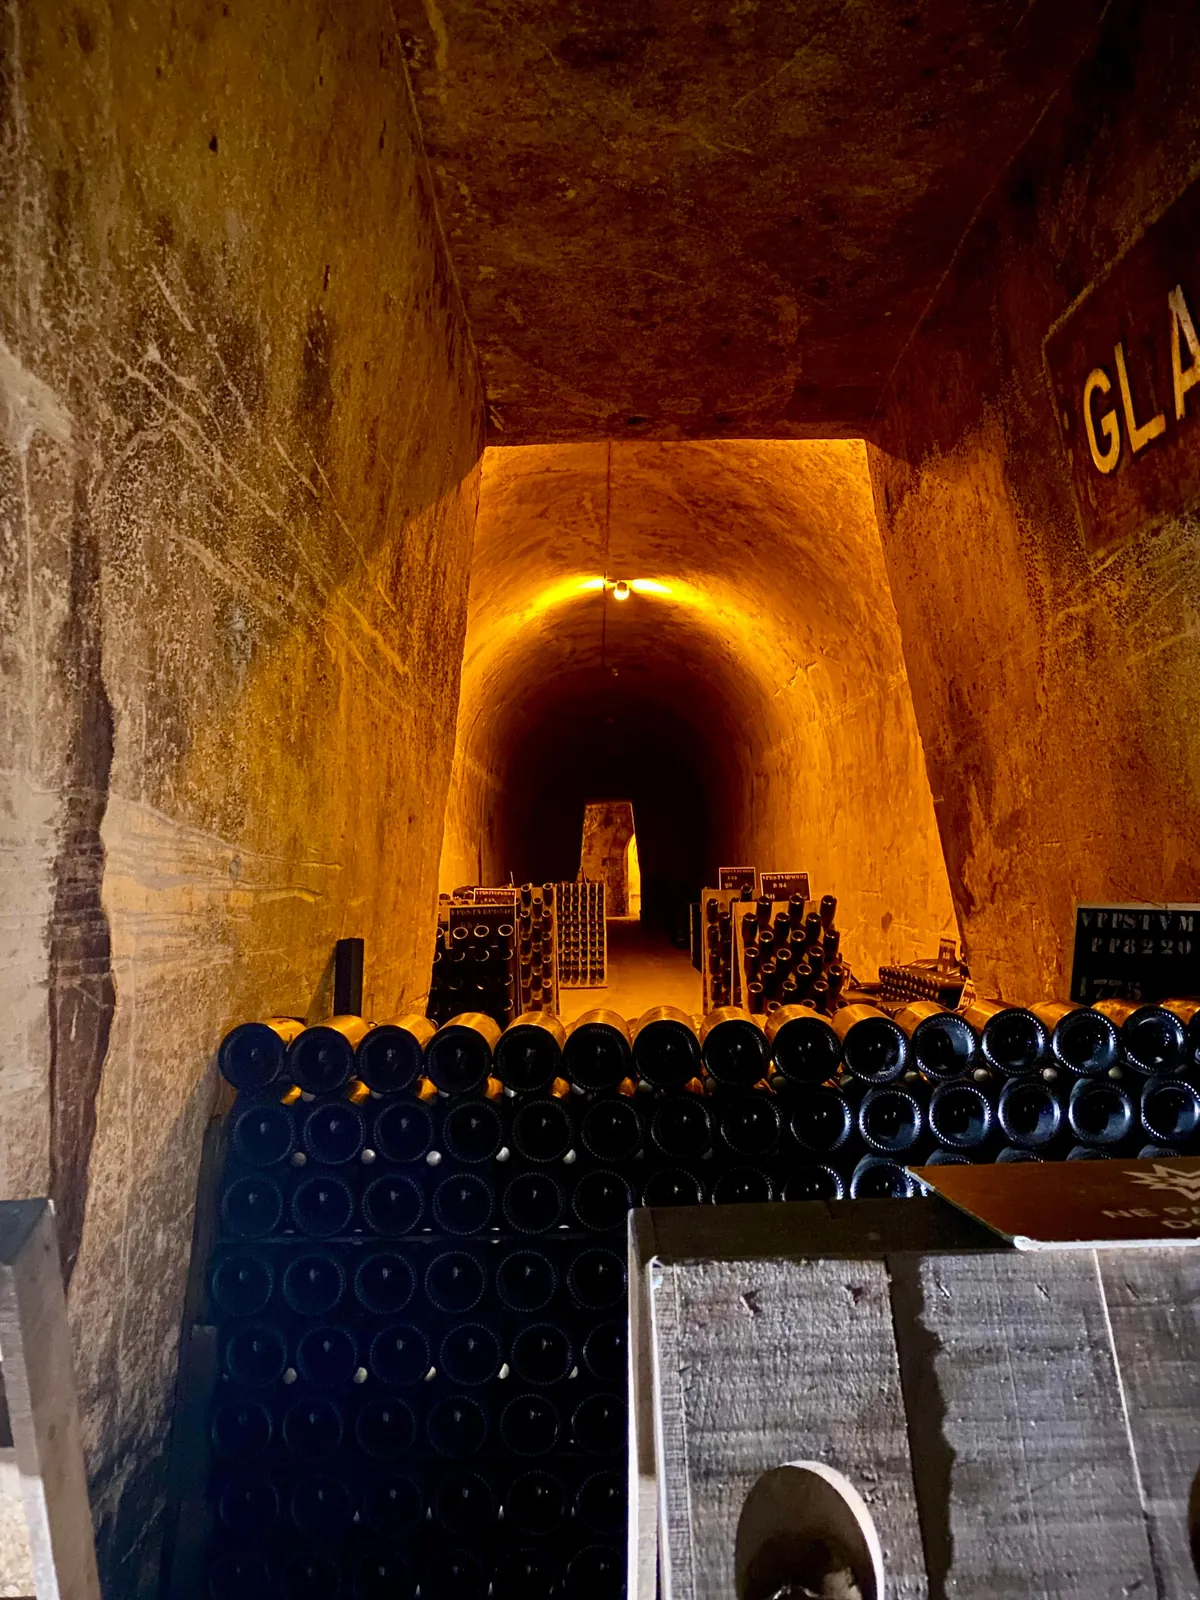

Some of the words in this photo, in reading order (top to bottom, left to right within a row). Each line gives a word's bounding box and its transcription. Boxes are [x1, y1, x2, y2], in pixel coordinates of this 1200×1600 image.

[1084, 284, 1200, 474] GLA
[1091, 937, 1192, 954] PP8220
[1101, 1208, 1158, 1218] NE
